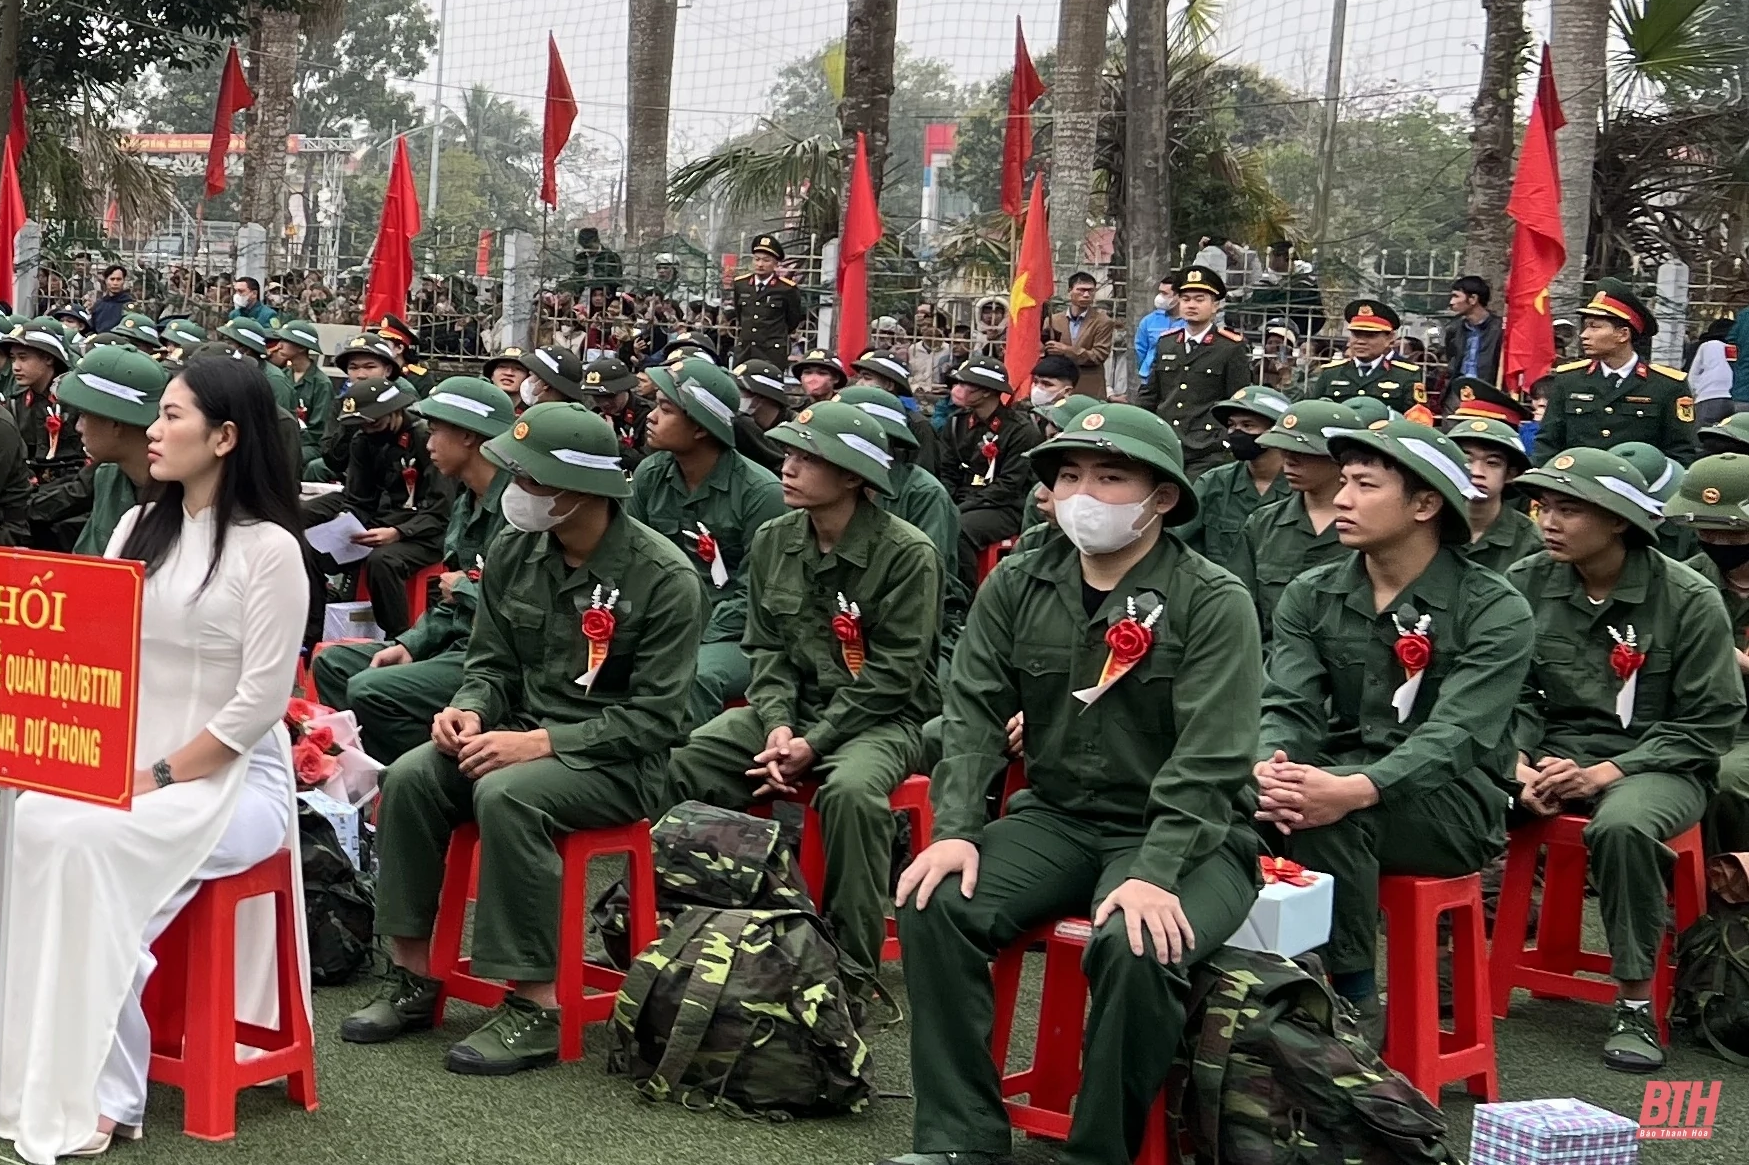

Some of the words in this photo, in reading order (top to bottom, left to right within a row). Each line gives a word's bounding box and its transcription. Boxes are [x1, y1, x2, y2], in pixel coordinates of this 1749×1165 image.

[5, 649, 47, 697] QUÂN
[49, 653, 123, 710] ĐỘI/BTTM
[24, 716, 47, 766] DỰ
[48, 715, 101, 769] PHÒNG
